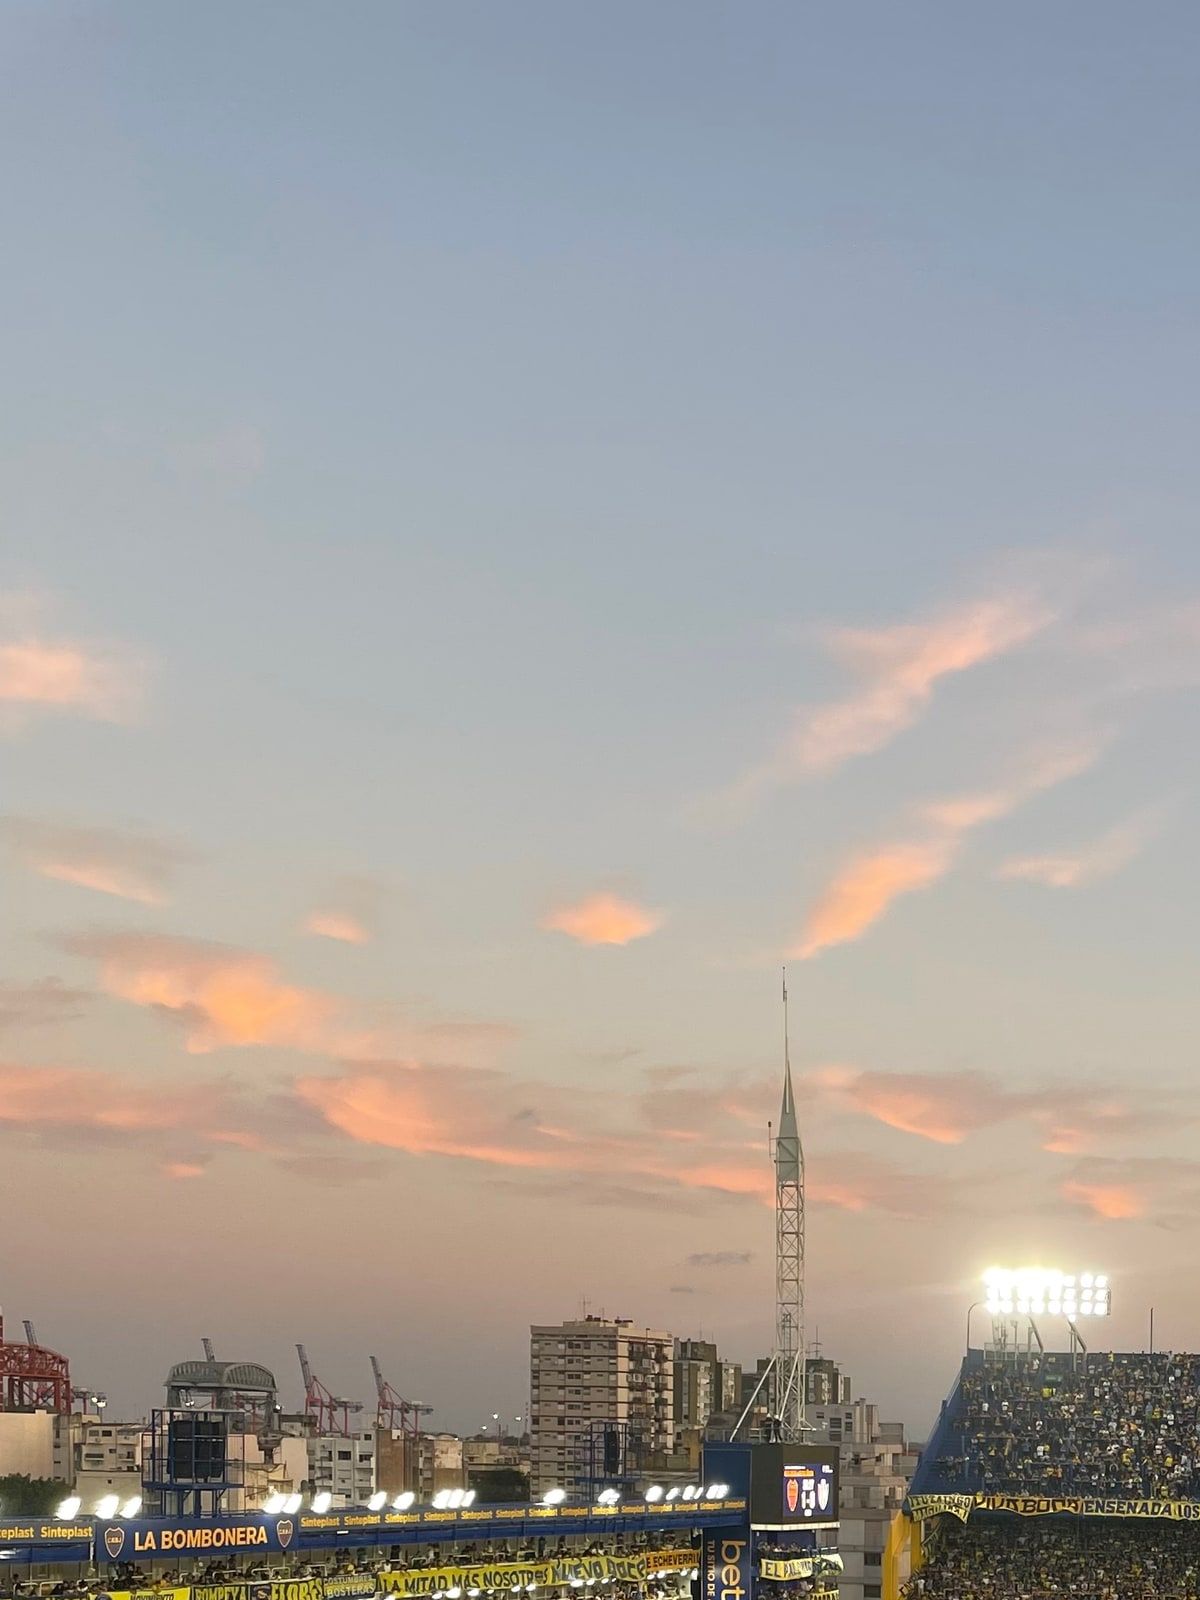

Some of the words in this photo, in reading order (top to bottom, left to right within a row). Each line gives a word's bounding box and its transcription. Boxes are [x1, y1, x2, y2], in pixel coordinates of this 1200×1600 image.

[1085, 1501, 1171, 1515] ENSENADA
[1178, 1505, 1200, 1518] LOS
[301, 1517, 340, 1528] Sinteplast
[344, 1515, 381, 1526] Sinteplast
[385, 1513, 420, 1524] Sinteplast
[424, 1512, 457, 1522] Sinteplast
[41, 1526, 93, 1540] Sinteplast
[134, 1531, 156, 1551] LA
[161, 1527, 268, 1549] BOMBONERA
[405, 1575, 448, 1592] MITAD
[707, 1584, 715, 1597] DE
